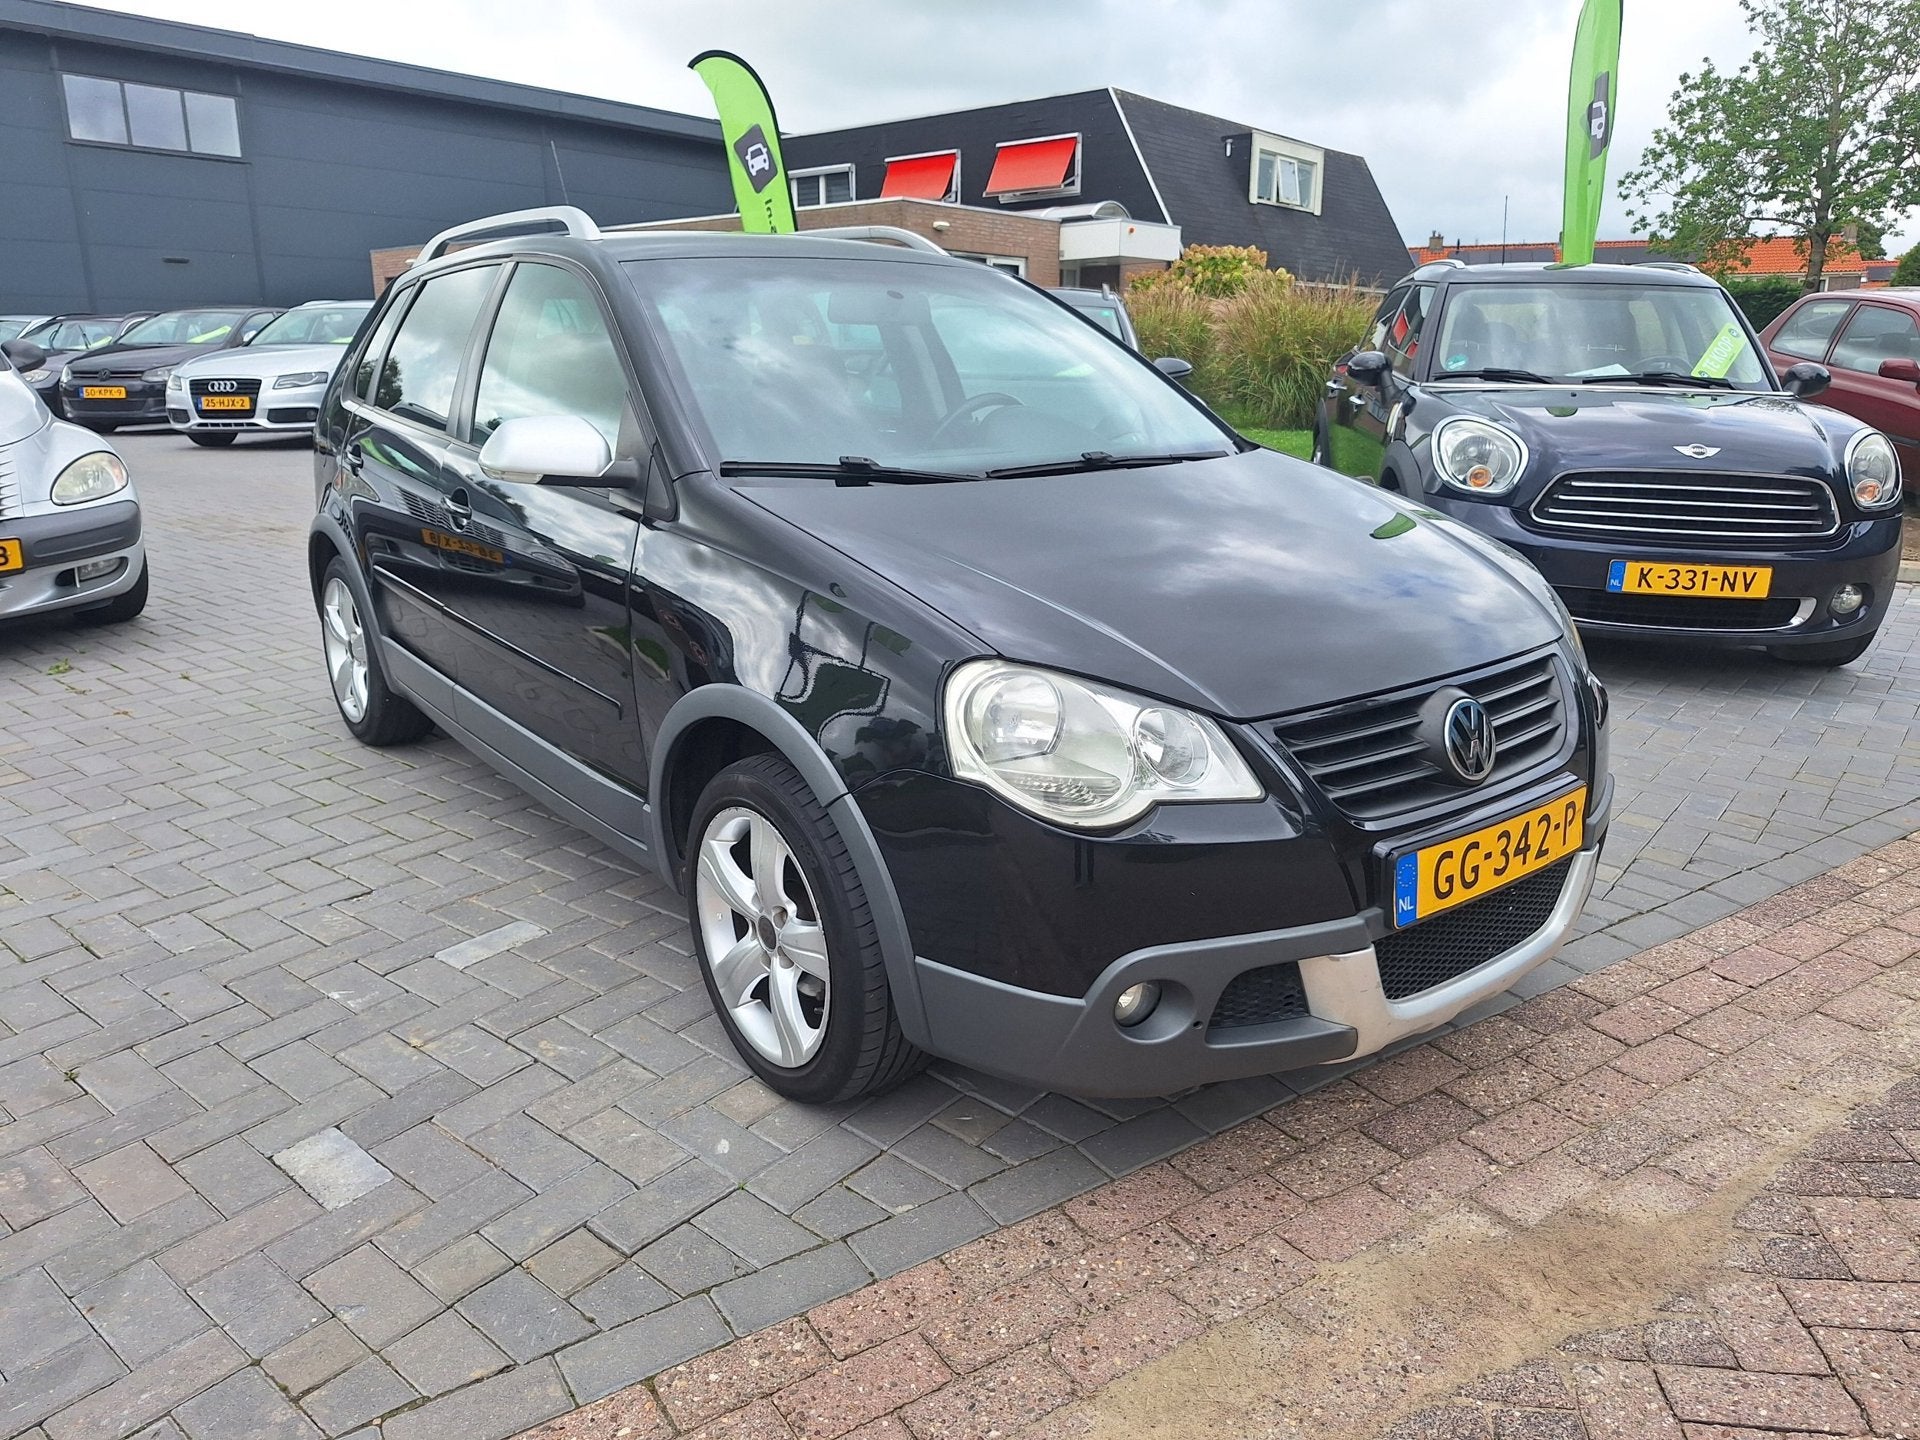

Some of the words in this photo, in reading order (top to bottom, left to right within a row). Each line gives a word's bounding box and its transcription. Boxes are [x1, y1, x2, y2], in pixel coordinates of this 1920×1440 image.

[1709, 336, 1734, 363] KOOP
[205, 398, 246, 408] 25-HJX-2
[1610, 579, 1621, 587] NL
[1637, 567, 1758, 593] K-331-NV
[1398, 895, 1414, 913] NL
[1433, 800, 1576, 900] GG-342-P
